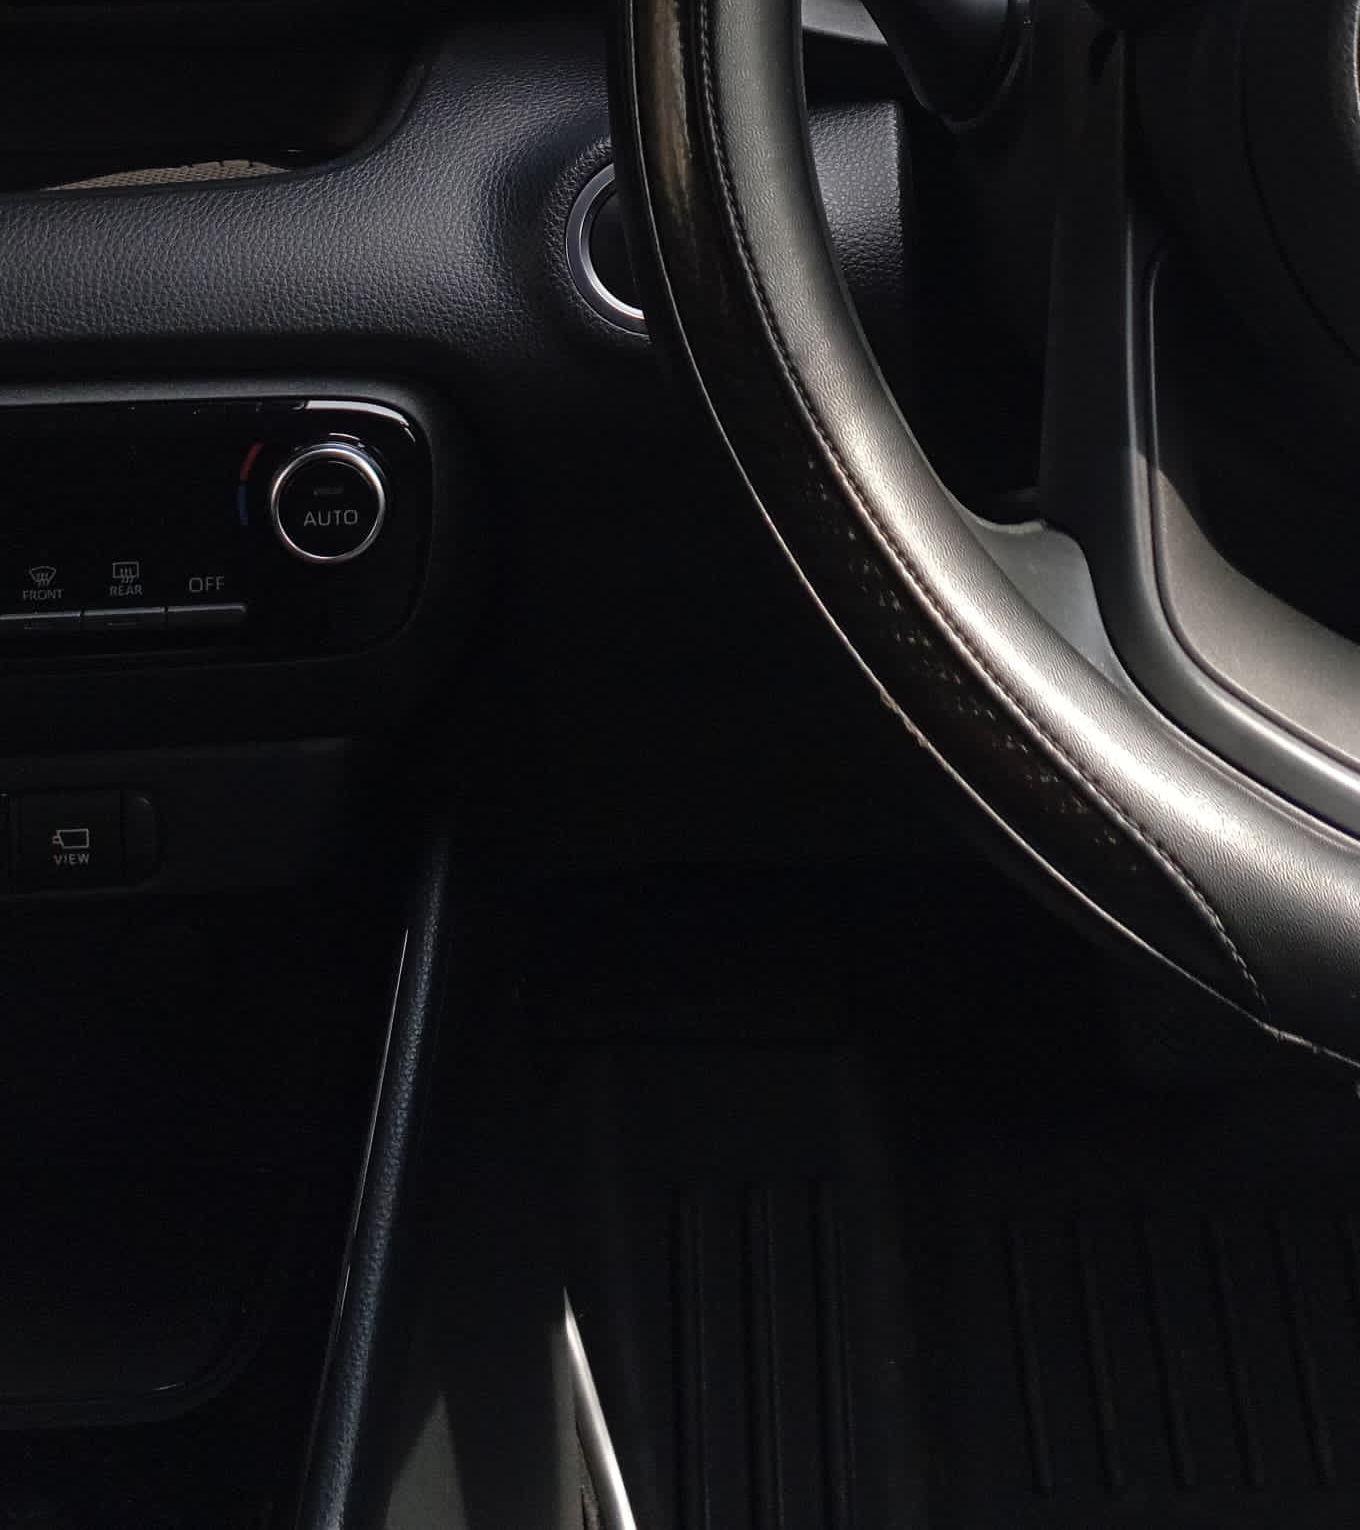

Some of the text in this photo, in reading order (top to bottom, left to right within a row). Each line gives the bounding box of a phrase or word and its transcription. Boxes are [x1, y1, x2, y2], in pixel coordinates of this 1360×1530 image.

[302, 509, 360, 528] AUTO
[109, 584, 143, 597] REAR
[187, 575, 226, 593] OFF
[22, 588, 64, 601] FRONT
[52, 852, 91, 866] VIEW
